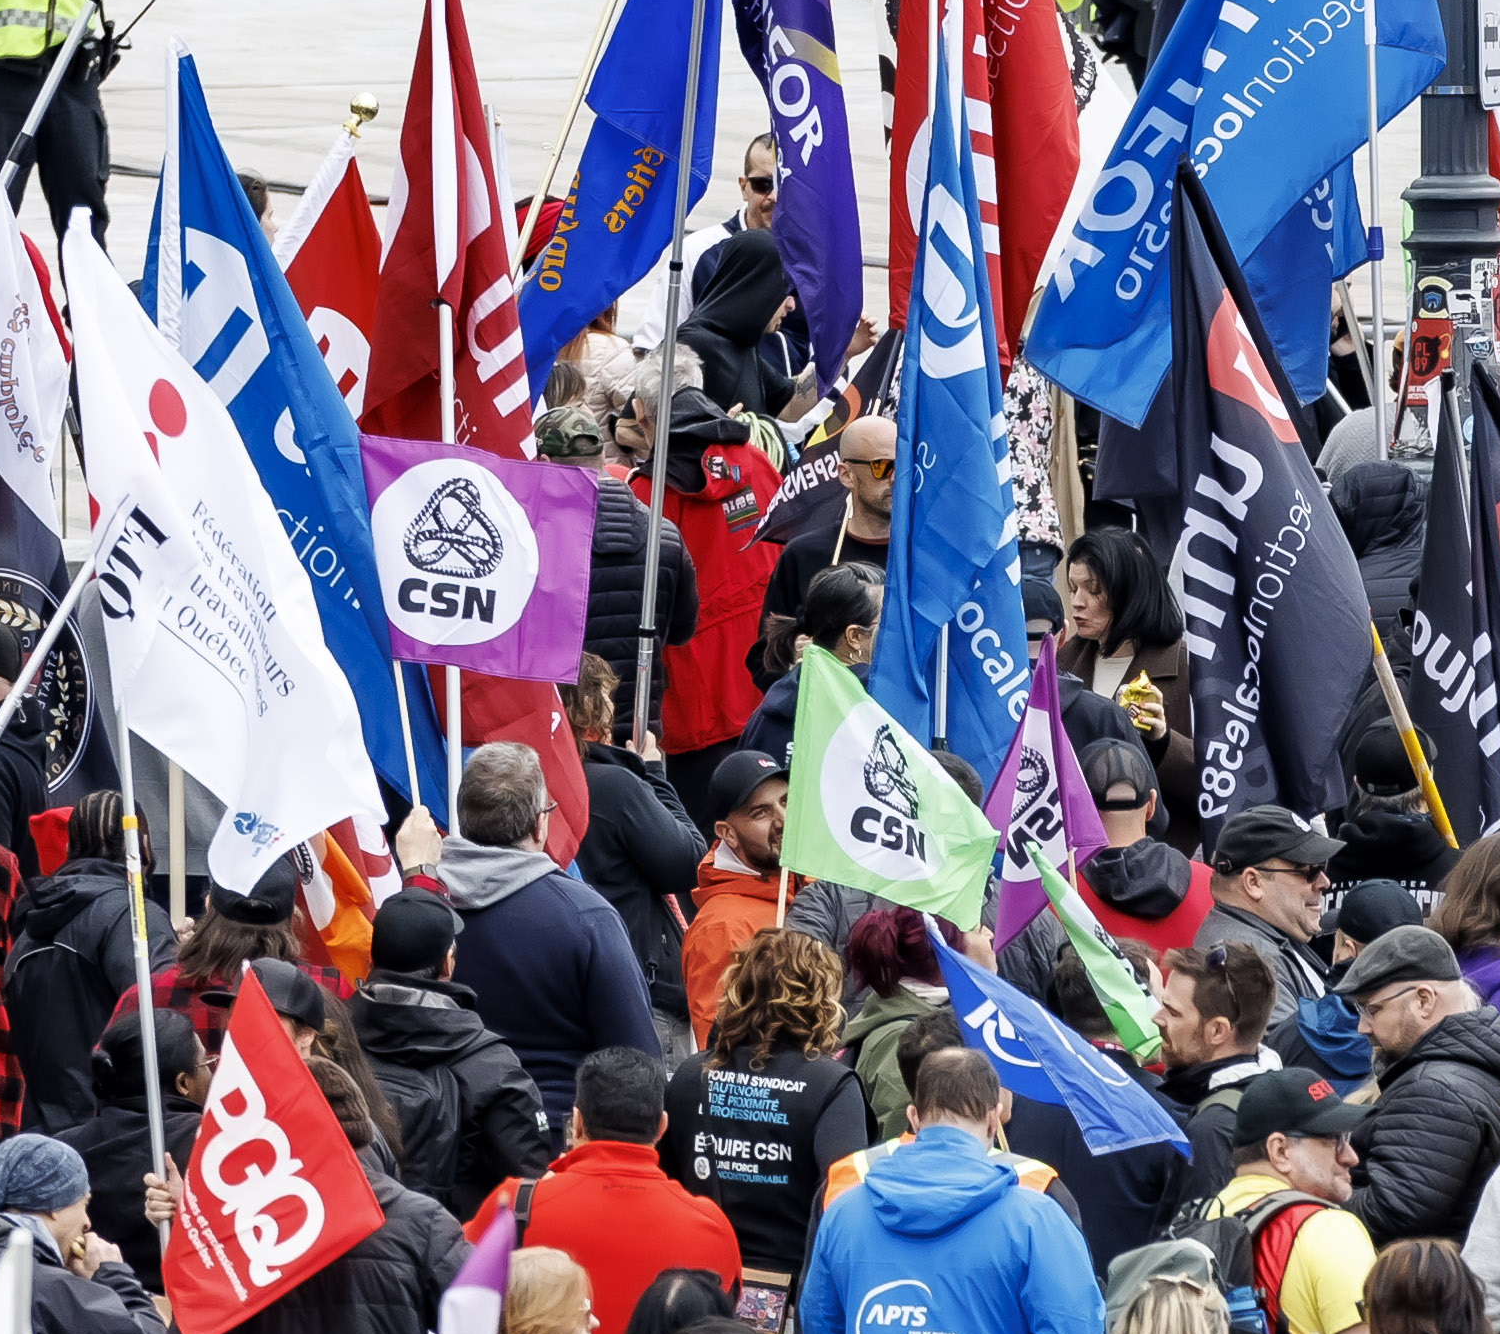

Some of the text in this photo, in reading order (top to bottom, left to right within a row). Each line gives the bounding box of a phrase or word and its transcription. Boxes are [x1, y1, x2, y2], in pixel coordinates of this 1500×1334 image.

[1414, 342, 1430, 357] PL
[190, 500, 279, 625] Fédération
[398, 578, 497, 623] CSN
[176, 605, 250, 685] Québec
[851, 807, 926, 862] CSN
[750, 1076, 807, 1094] SYNDICAT
[754, 1142, 792, 1162] CSN
[866, 1303, 927, 1327] APTS
